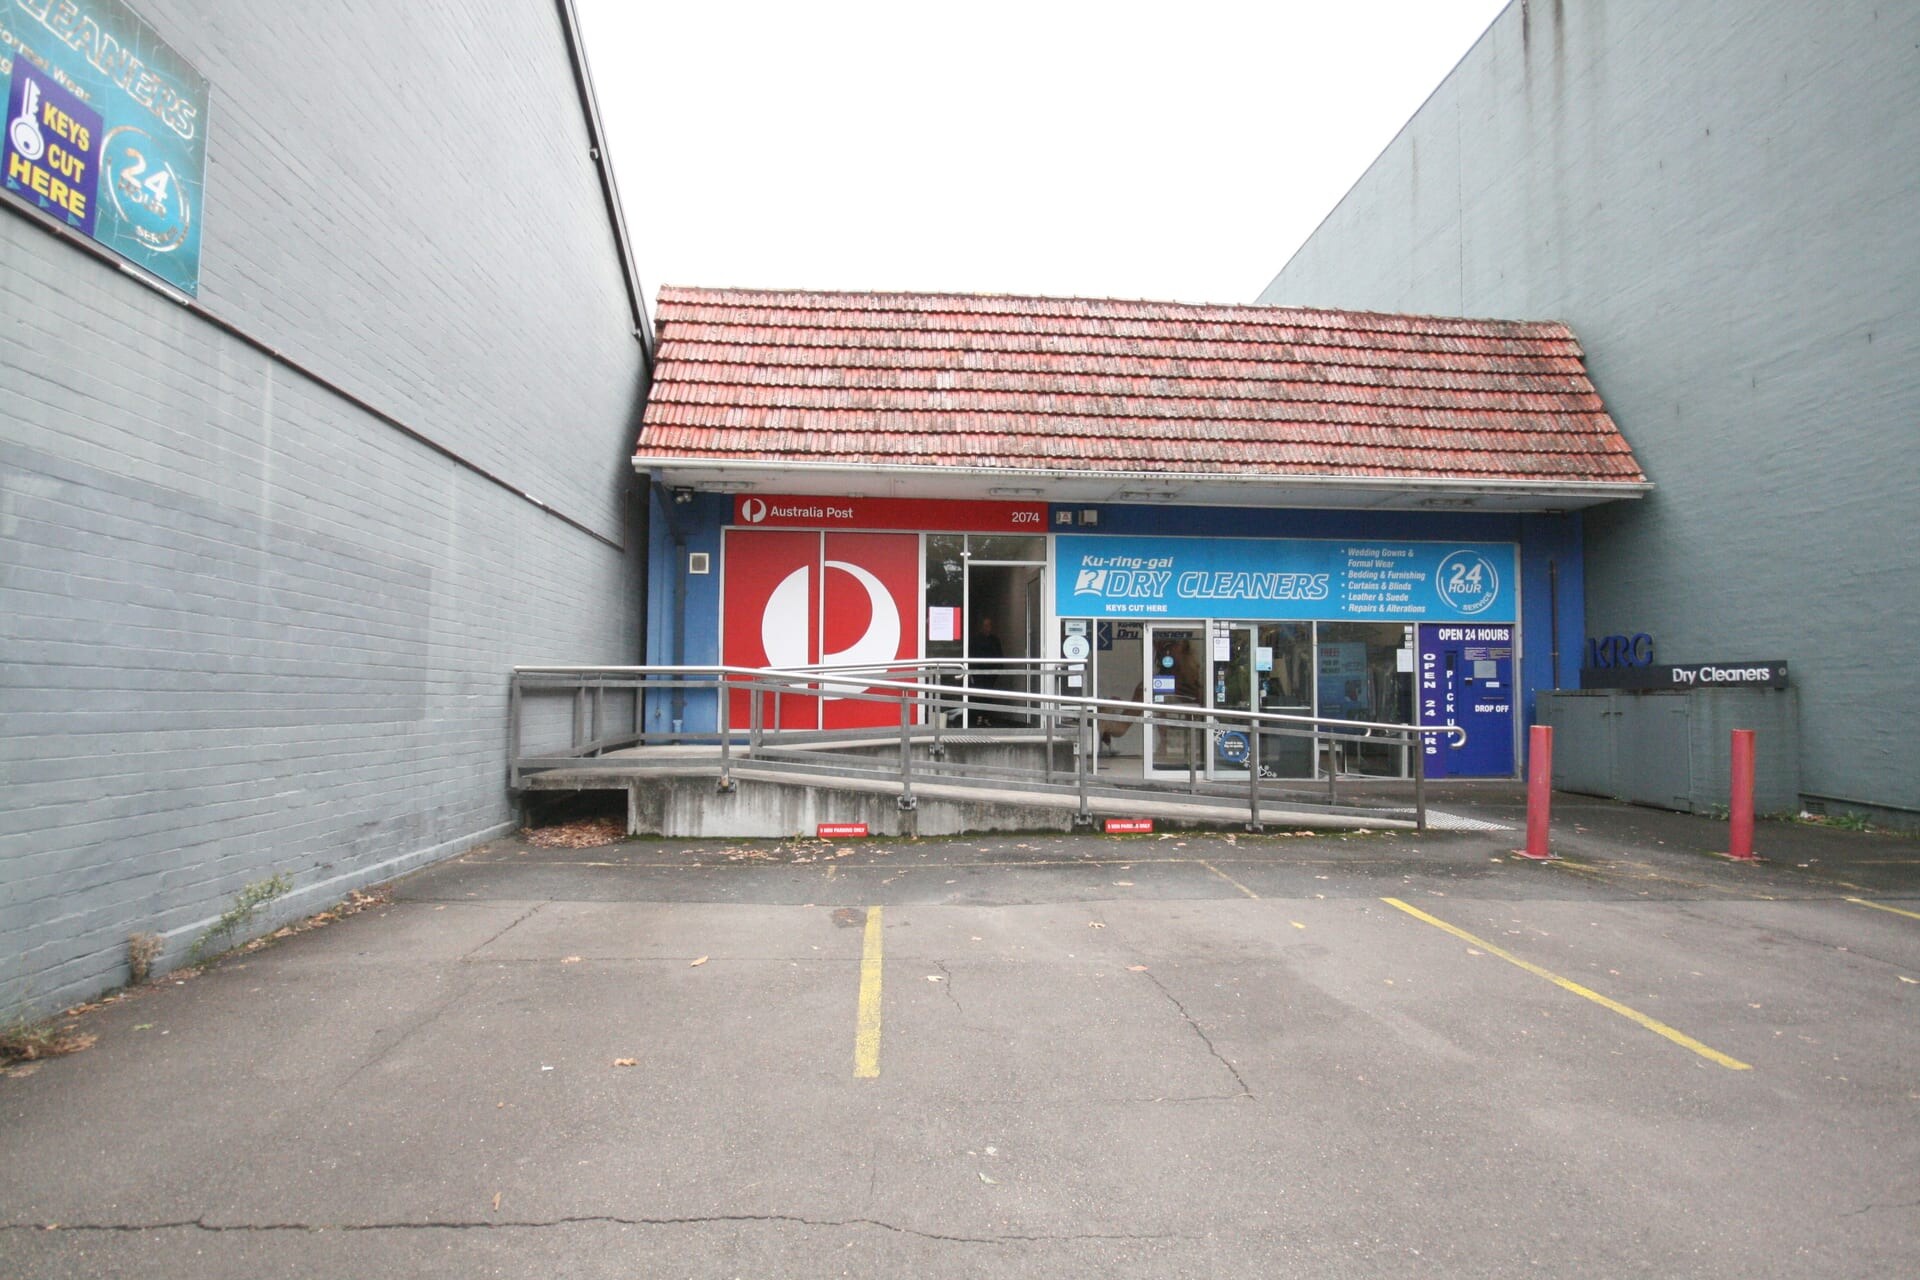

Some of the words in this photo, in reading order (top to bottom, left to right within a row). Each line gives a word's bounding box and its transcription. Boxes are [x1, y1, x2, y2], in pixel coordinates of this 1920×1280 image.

[43, 101, 90, 152] KEYS
[48, 143, 85, 184] CUT
[120, 148, 169, 201] 24
[9, 153, 87, 219] HERE
[770, 505, 823, 518] Australia
[827, 507, 853, 519] Post
[1011, 511, 1040, 523] 2074
[1347, 547, 1380, 557] Wedding
[1381, 548, 1406, 557] Gowns
[1407, 549, 1414, 557] &
[1082, 555, 1174, 569] Ku-ring-gai
[1347, 559, 1373, 568] Formal
[1375, 559, 1394, 568] Wear
[1347, 570, 1378, 580] Bedding
[1379, 571, 1386, 579] &
[1387, 571, 1426, 581] Furnishing
[1450, 563, 1482, 584] 24
[1106, 570, 1171, 598] DRY
[1177, 571, 1329, 600] CLEANERS
[1348, 582, 1379, 590] Curtains
[1381, 582, 1387, 590] &
[1389, 582, 1412, 590] Blinds
[1448, 583, 1482, 594] HOUR
[1348, 593, 1376, 601] Leather
[1378, 593, 1384, 601] &
[1386, 593, 1409, 601] Suede
[1462, 591, 1493, 611] SERVICE
[1105, 603, 1127, 612] KEYS
[1128, 604, 1144, 612] CUT
[1146, 604, 1168, 612] HERE
[1348, 604, 1378, 613] Repairs
[1379, 604, 1386, 613] &
[1387, 604, 1426, 613] Alterations
[1439, 629, 1463, 640] OPEN
[1465, 629, 1476, 640] 24
[1478, 629, 1509, 640] HOURS
[1423, 653, 1436, 688] OPEN
[1672, 668, 1696, 685] Dry
[1700, 667, 1770, 682] Cleaners
[1446, 670, 1454, 712] PICK
[1425, 700, 1436, 717] 24
